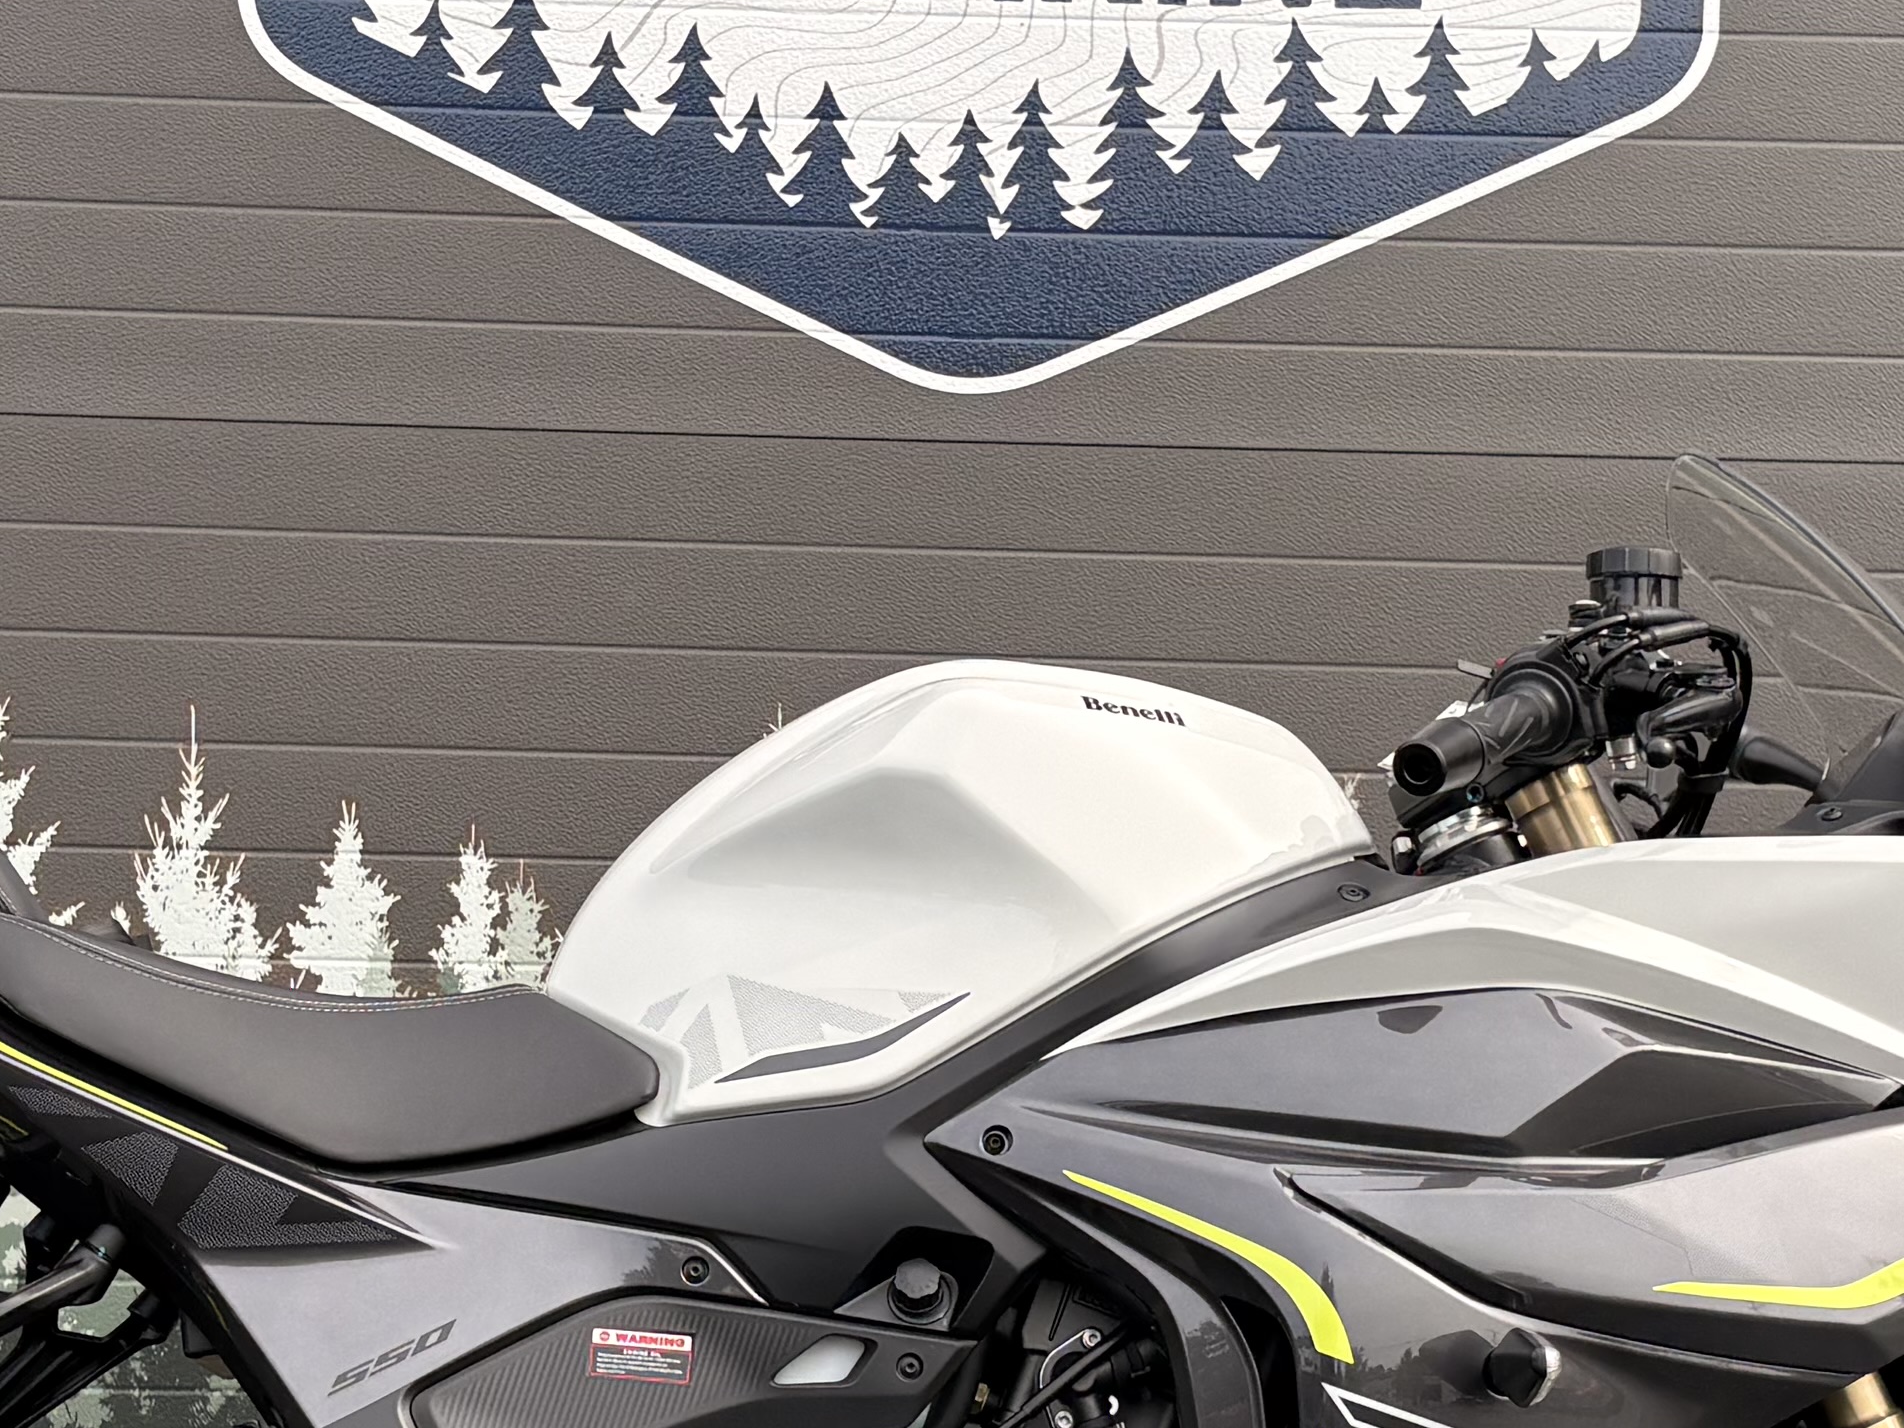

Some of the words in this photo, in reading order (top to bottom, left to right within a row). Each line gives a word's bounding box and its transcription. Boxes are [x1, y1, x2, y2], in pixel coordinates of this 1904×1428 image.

[1080, 694, 1187, 728] Benelli
[615, 1331, 686, 1349] WARNING
[326, 1317, 458, 1398] 550
